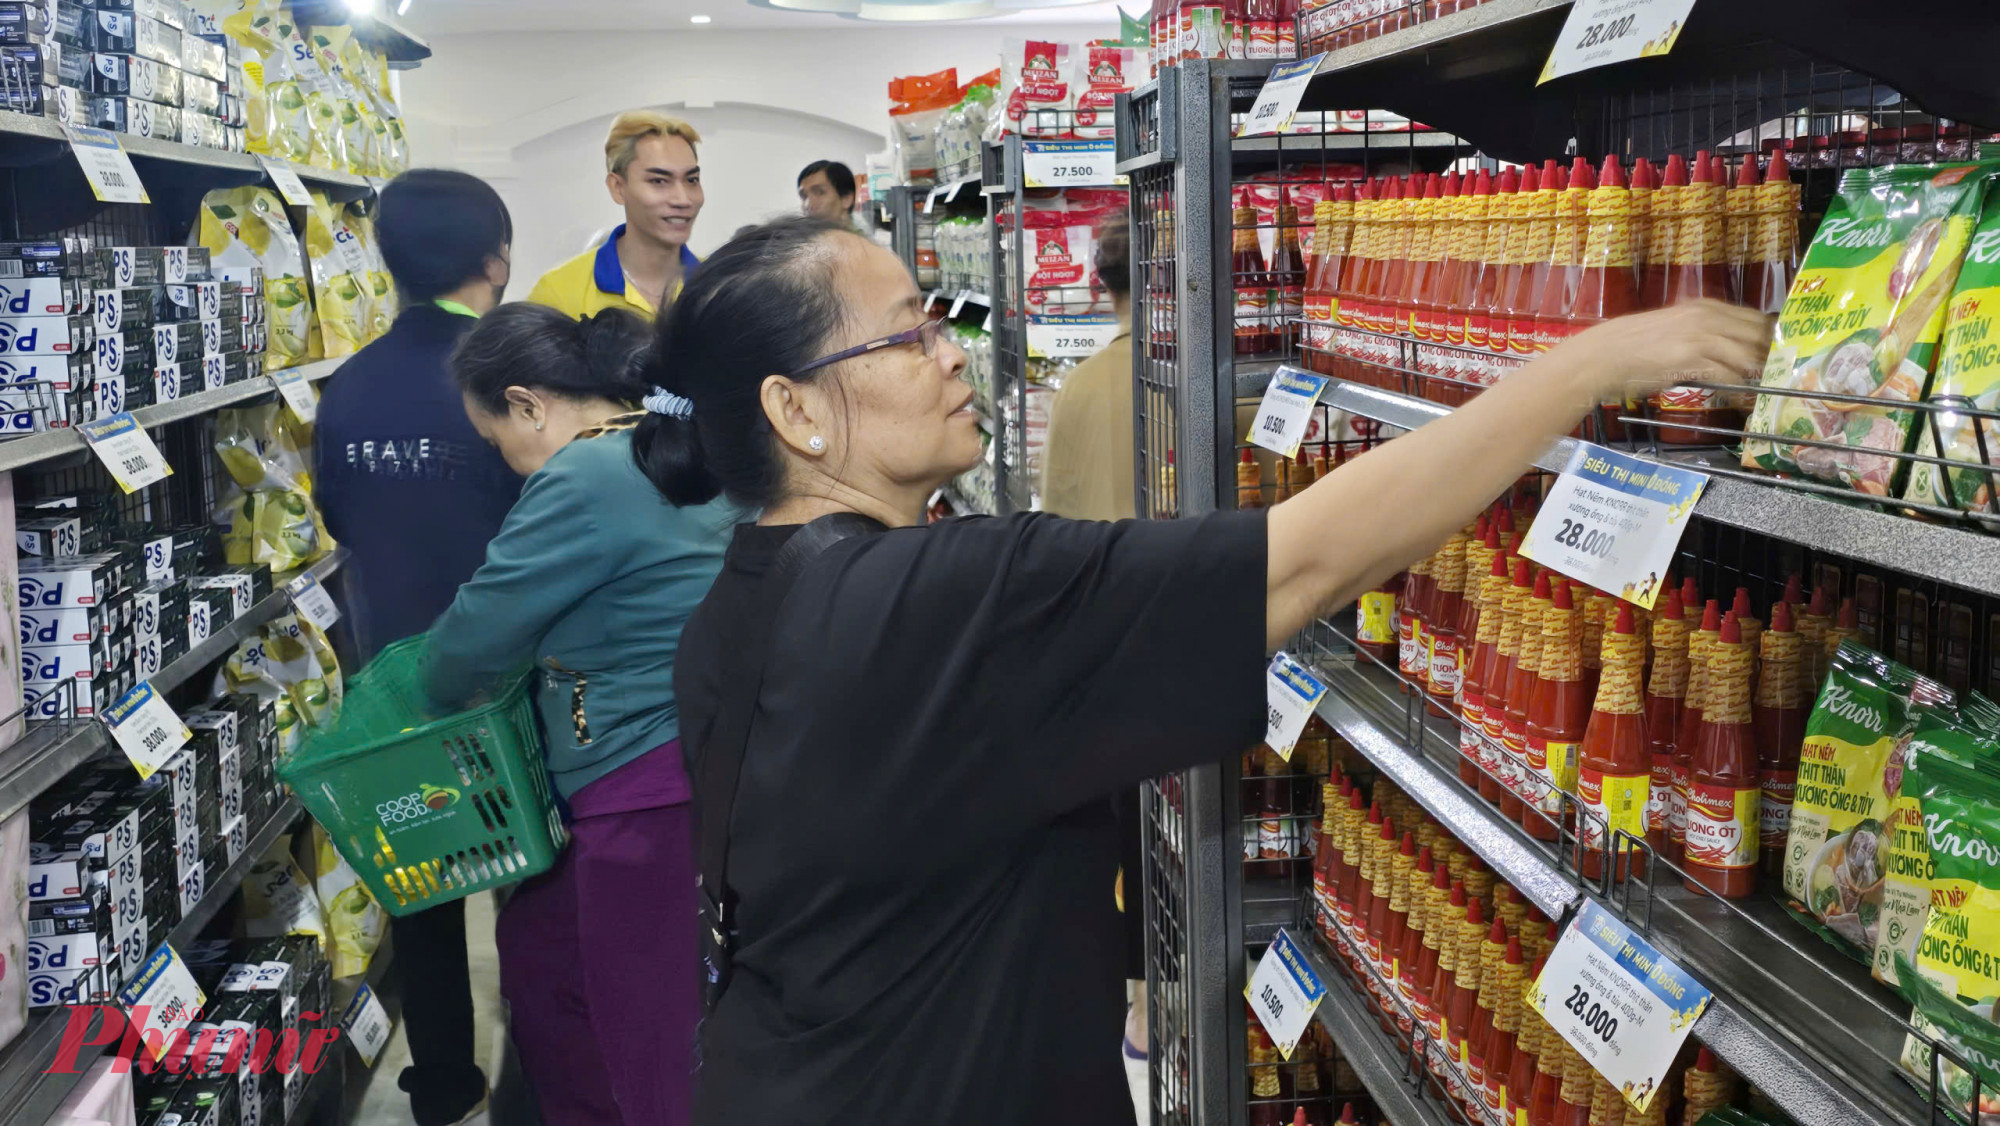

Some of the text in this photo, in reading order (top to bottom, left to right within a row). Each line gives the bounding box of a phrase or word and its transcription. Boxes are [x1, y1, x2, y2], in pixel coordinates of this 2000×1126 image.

[1576, 13, 1635, 50] 28.000
[1053, 166, 1093, 177] 27.500
[1814, 217, 1893, 248] Knorr
[1055, 338, 1095, 349] 27.500
[1584, 457, 1611, 475] SIÊU
[1610, 466, 1630, 486] THỊ
[1555, 518, 1615, 559] 28.000
[1820, 685, 1883, 732] Knorr
[142, 727, 168, 752] 38.000
[1803, 743, 1836, 761] HẠT NÊM
[1800, 760, 1847, 787] THỊT THĂN
[376, 793, 421, 815] COOP
[1687, 788, 1732, 808] Cholimex
[1850, 798, 1858, 813] &
[381, 804, 428, 827] FOOD
[1600, 926, 1621, 947] SIÊU
[1619, 940, 1636, 960] THỊ
[1633, 952, 1655, 974] MINI
[1650, 964, 1663, 980] 0
[1953, 938, 1982, 974] ỐNG
[1984, 957, 1993, 979] &
[1586, 952, 1598, 967] Hạt
[1596, 961, 1611, 978] Nêm
[1608, 970, 1631, 994] KNORR
[1261, 984, 1284, 1018] 10.500
[1564, 984, 1618, 1043] 28.000
